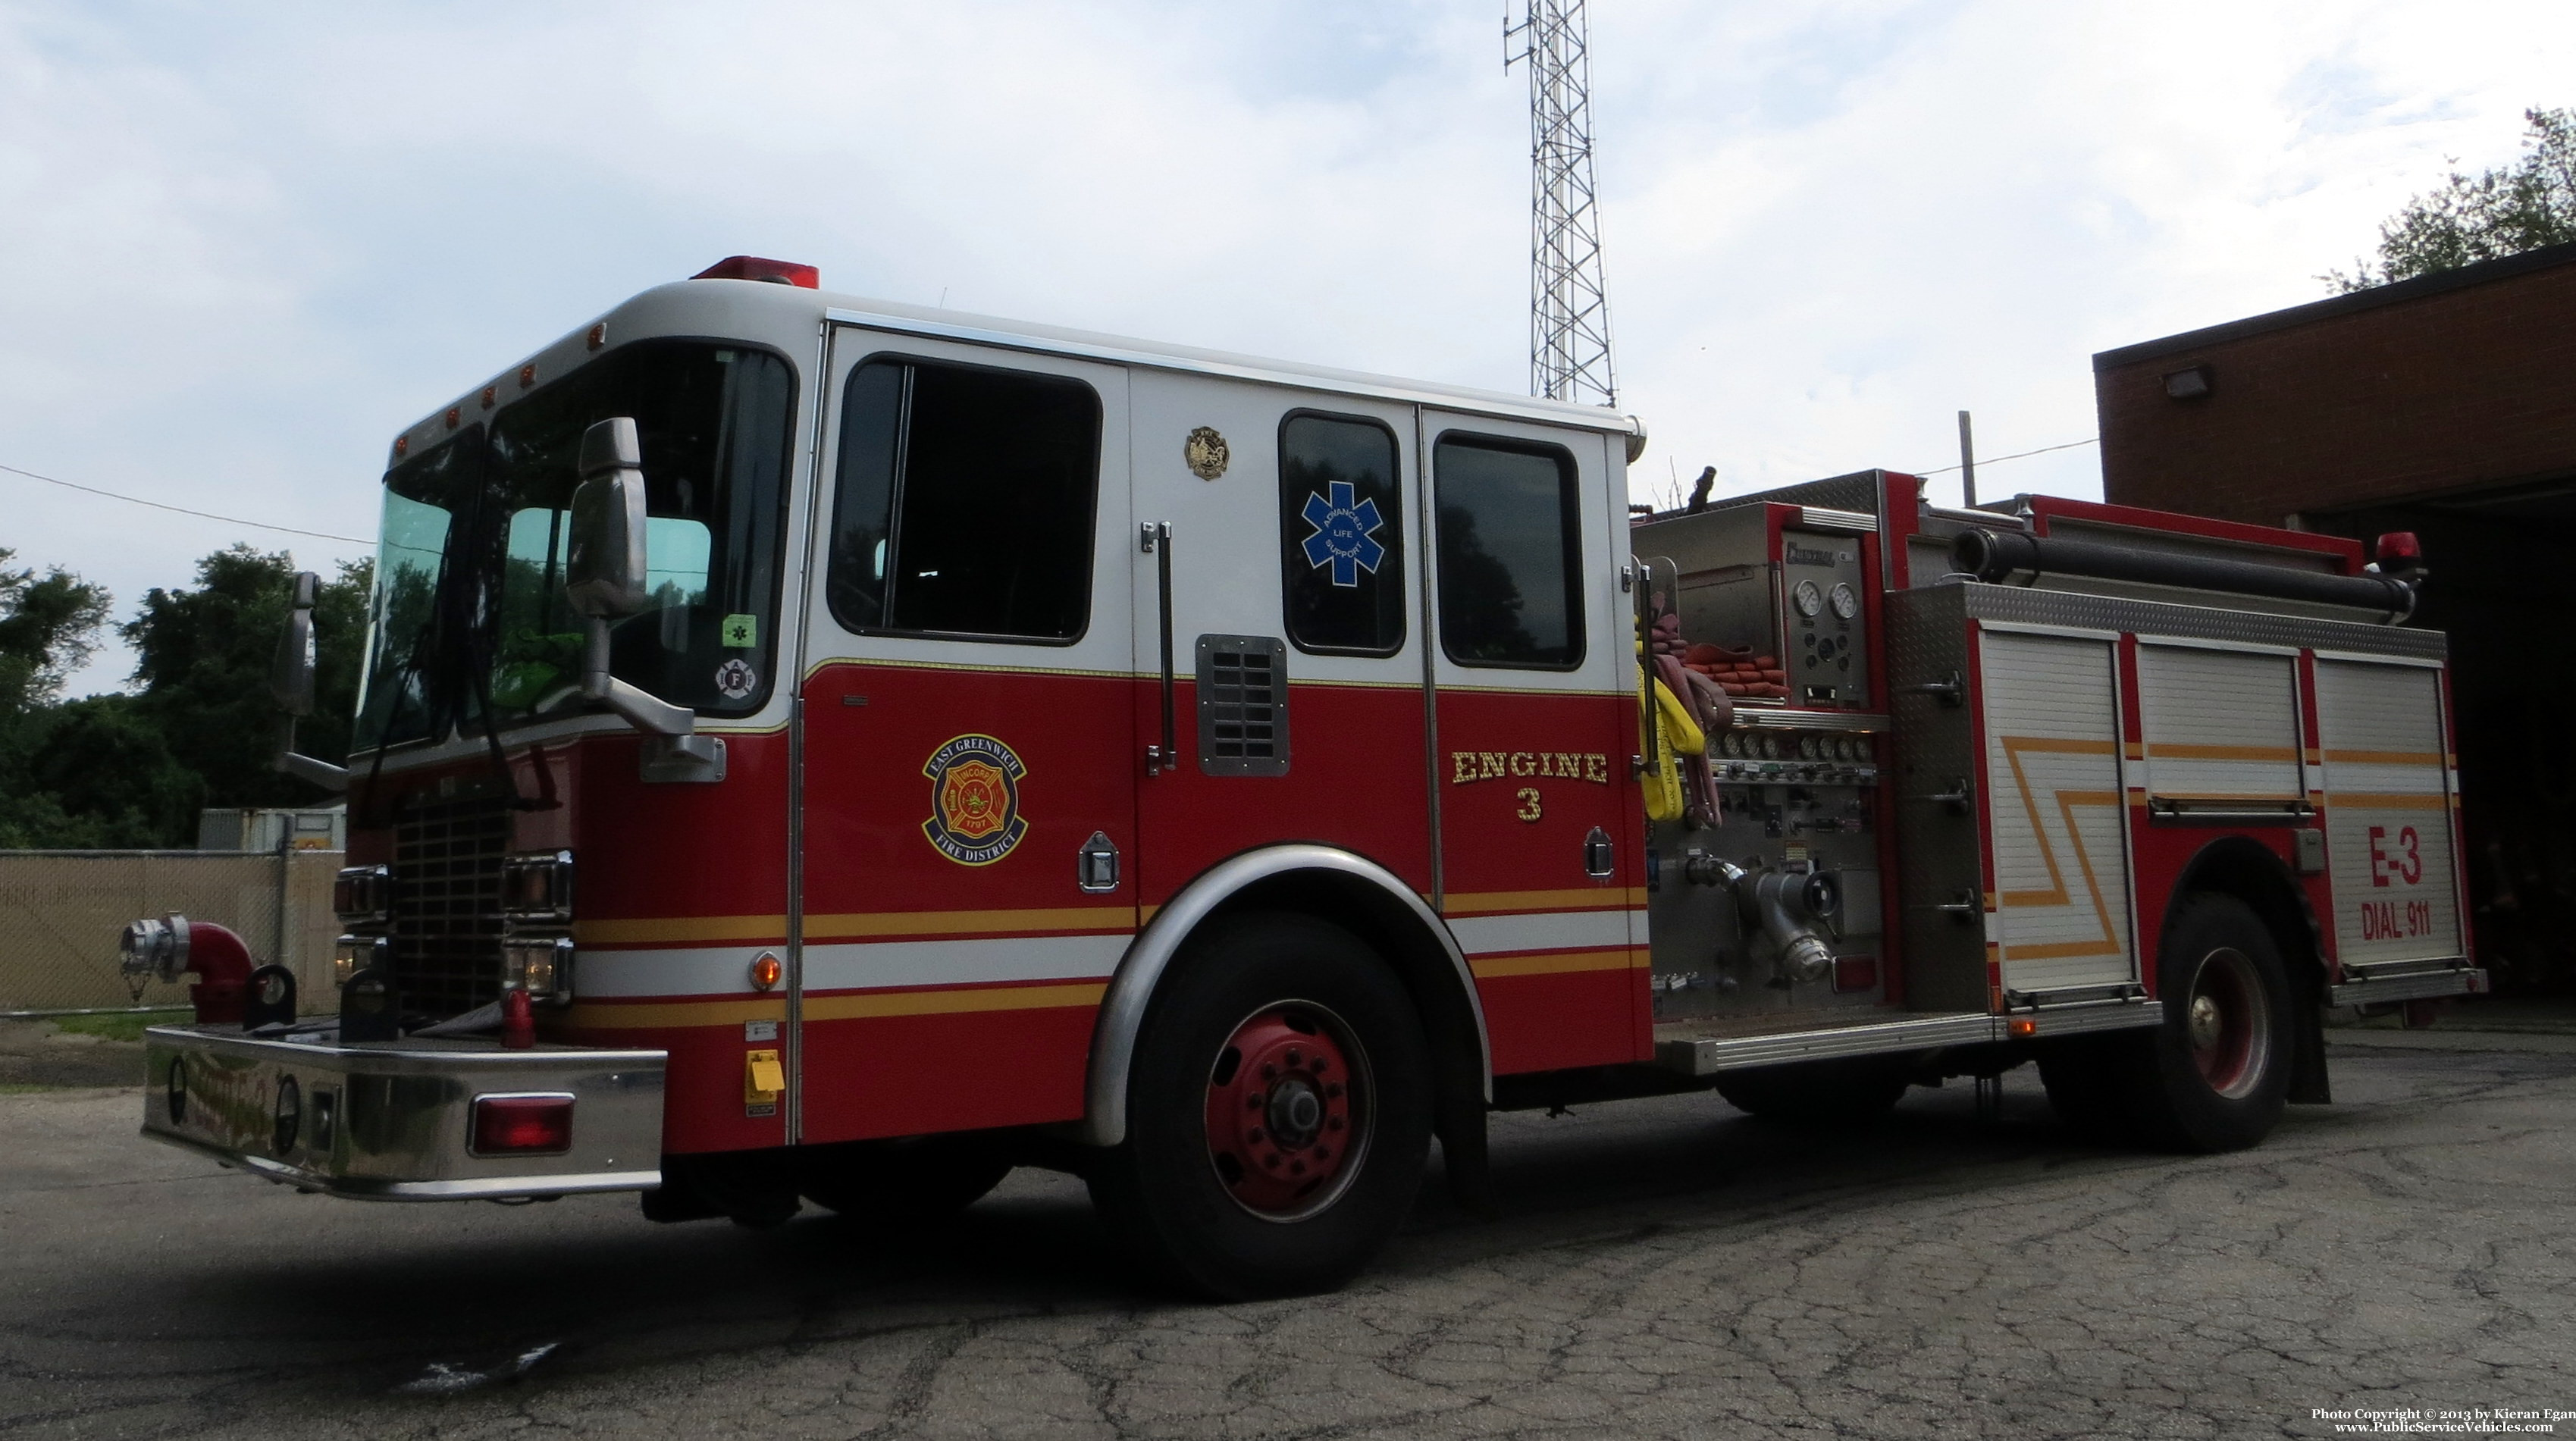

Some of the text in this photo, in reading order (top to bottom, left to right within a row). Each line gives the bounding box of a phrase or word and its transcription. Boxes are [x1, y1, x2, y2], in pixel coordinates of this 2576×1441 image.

[1323, 508, 1364, 531] ADVANCED
[1333, 529, 1354, 538] LIFE
[1325, 539, 1363, 558] SUPPORT
[930, 738, 1020, 772] EAST GREENWICH
[1451, 751, 1608, 784] ENGINE
[1516, 787, 1542, 822] 3
[966, 819, 986, 829] 1797
[935, 831, 1017, 862] FIRE DISTRICT
[2368, 825, 2422, 888] E-3
[2361, 900, 2431, 941] DIAL 911
